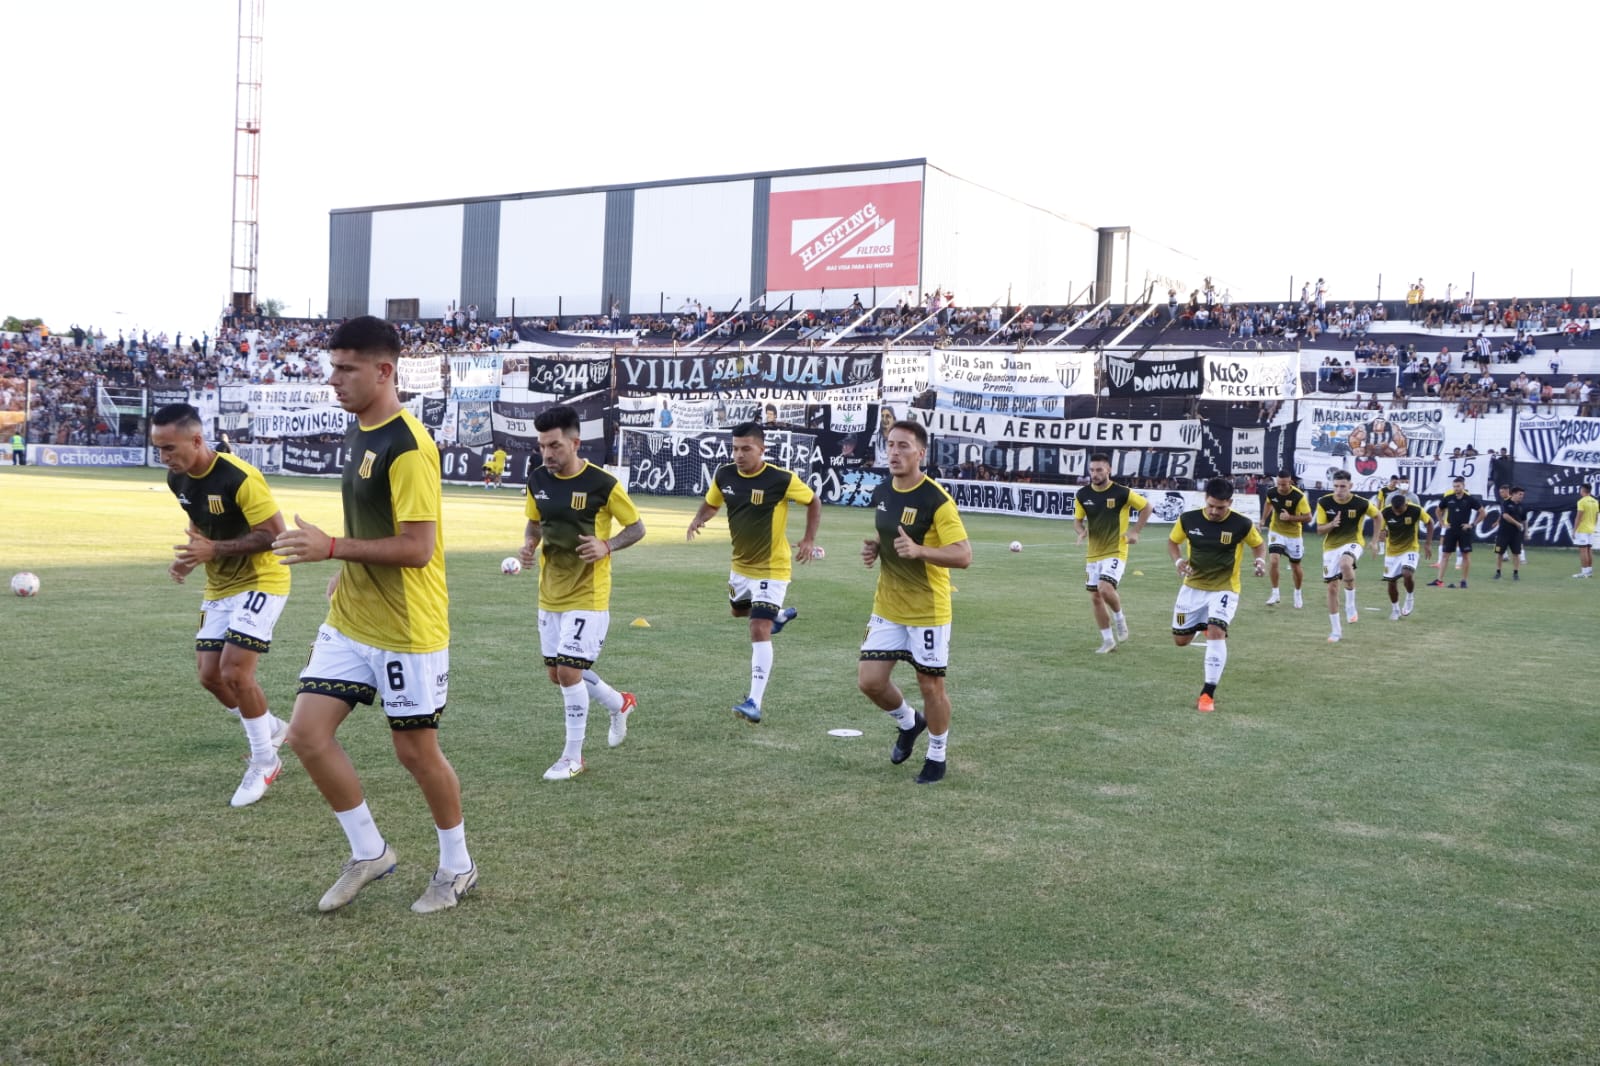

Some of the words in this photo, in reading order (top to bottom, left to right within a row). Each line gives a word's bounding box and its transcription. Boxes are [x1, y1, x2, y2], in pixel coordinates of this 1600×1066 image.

[798, 202, 877, 266] HASTING
[857, 245, 891, 255] FILTROS
[620, 356, 708, 389] VILLA
[711, 353, 761, 382] SAN
[762, 354, 849, 386] JUAN
[943, 353, 969, 368] Villa
[973, 357, 993, 370] San
[1000, 358, 1032, 370] Juan
[1151, 363, 1176, 373] VILLA
[552, 363, 590, 390] 244
[1133, 370, 1199, 392] DONOVAN
[883, 385, 913, 393] SIEMPRE
[1220, 384, 1281, 397] PRESENTE
[1389, 409, 1442, 423] MORENO
[922, 410, 986, 436] VILLA
[1003, 420, 1162, 442] AEROPUERTO
[60, 453, 122, 465] CETROGAR
[1232, 461, 1263, 470] PASION
[1447, 457, 1475, 480] 15
[1111, 558, 1119, 570] 3
[242, 590, 267, 614] 10
[1220, 593, 1228, 608] 4
[573, 617, 586, 641] 7
[923, 629, 934, 650] 9
[386, 660, 405, 692] 6
